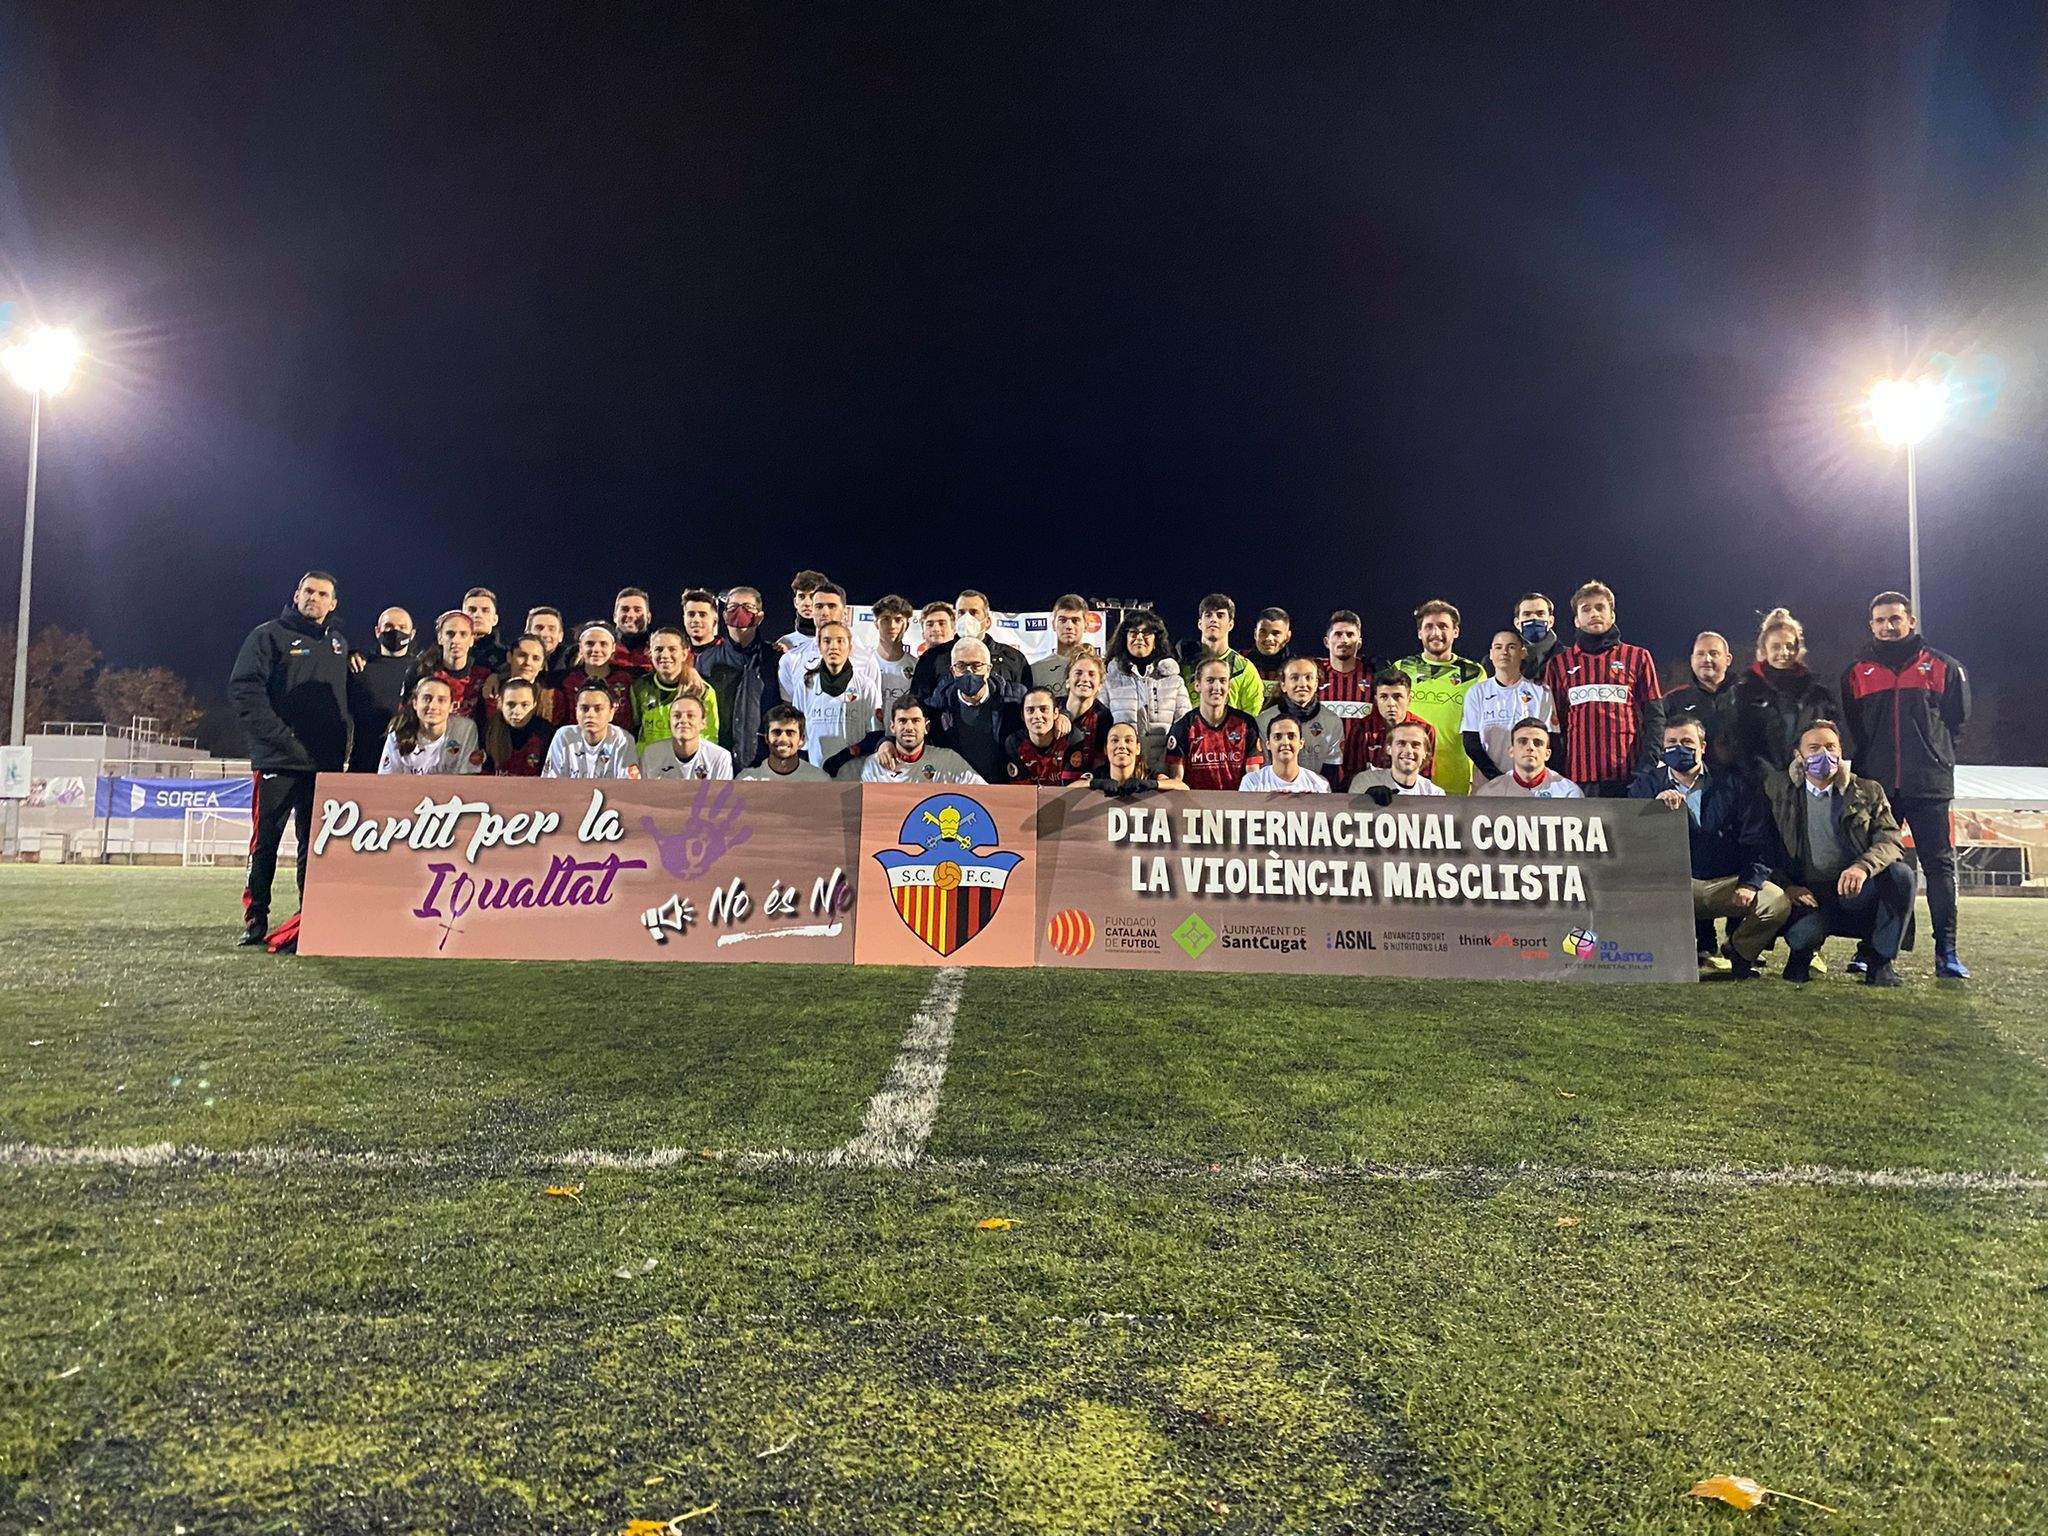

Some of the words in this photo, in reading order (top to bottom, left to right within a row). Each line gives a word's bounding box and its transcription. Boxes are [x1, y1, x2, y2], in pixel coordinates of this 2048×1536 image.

[157, 791, 220, 807] SOREA
[314, 795, 489, 855] Partit
[465, 809, 560, 863] per
[577, 788, 624, 843] la
[1107, 807, 1171, 843] DIA
[1182, 808, 1462, 850] INTERNACIONAL
[1471, 814, 1608, 852] CONTRA
[1131, 856, 1170, 892] LA
[1181, 850, 1373, 897] VIOLÈNCIA
[1383, 861, 1587, 902] MASCLISTA
[708, 876, 749, 924] No
[763, 880, 795, 915] és
[1105, 916, 1156, 927] FUNDACIÓ
[1105, 928, 1157, 938] CATALANA
[1221, 925, 1290, 936] AJUNTAMENT
[1293, 926, 1306, 936] DE
[1383, 932, 1420, 941] ADVANCED
[1421, 932, 1445, 942] SPORT
[1105, 938, 1119, 948] DE
[1121, 939, 1160, 949] FUTBOL
[1221, 935, 1307, 953] SantCugat
[1335, 930, 1376, 950] ASNL
[1390, 942, 1433, 952] NUTRITIONS
[1434, 943, 1448, 952] LAB
[1459, 934, 1492, 946] think
[1512, 937, 1548, 949] sport
